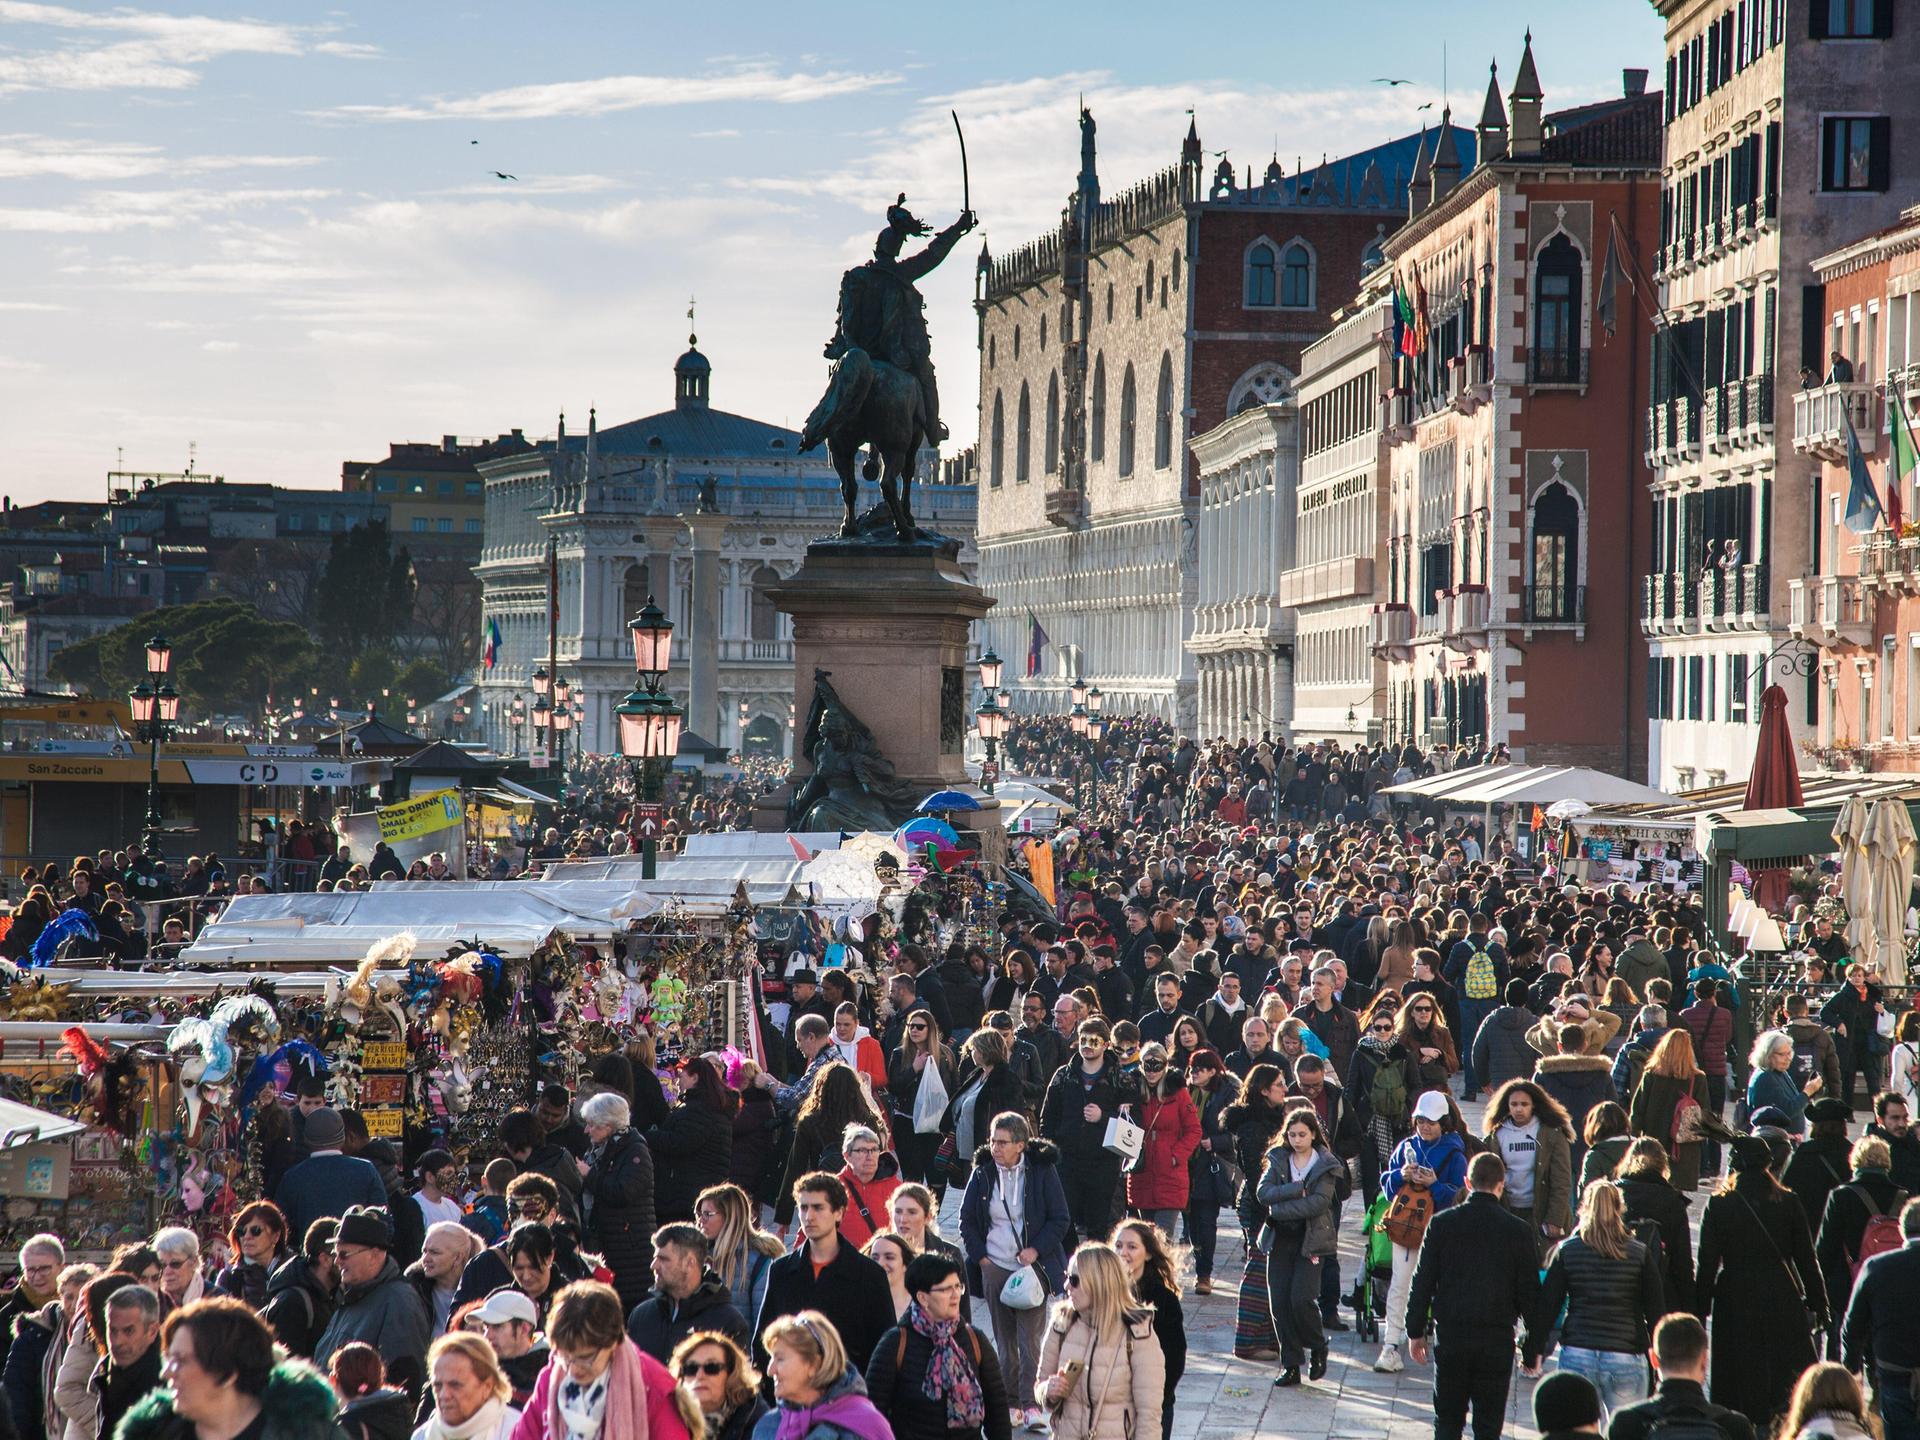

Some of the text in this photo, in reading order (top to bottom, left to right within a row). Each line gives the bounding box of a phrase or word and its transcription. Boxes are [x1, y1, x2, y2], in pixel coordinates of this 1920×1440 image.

[28, 763, 104, 775] San Zaccaria
[240, 764, 279, 782] C D
[327, 770, 345, 779] Actv
[379, 809, 406, 819] COLD
[408, 796, 440, 813] DRINK
[381, 818, 407, 829] SMALL
[383, 829, 398, 838] BIG
[1652, 830, 1661, 839] &
[377, 1118, 401, 1127] RIALTO
[1509, 1142, 1535, 1152] PUMA
